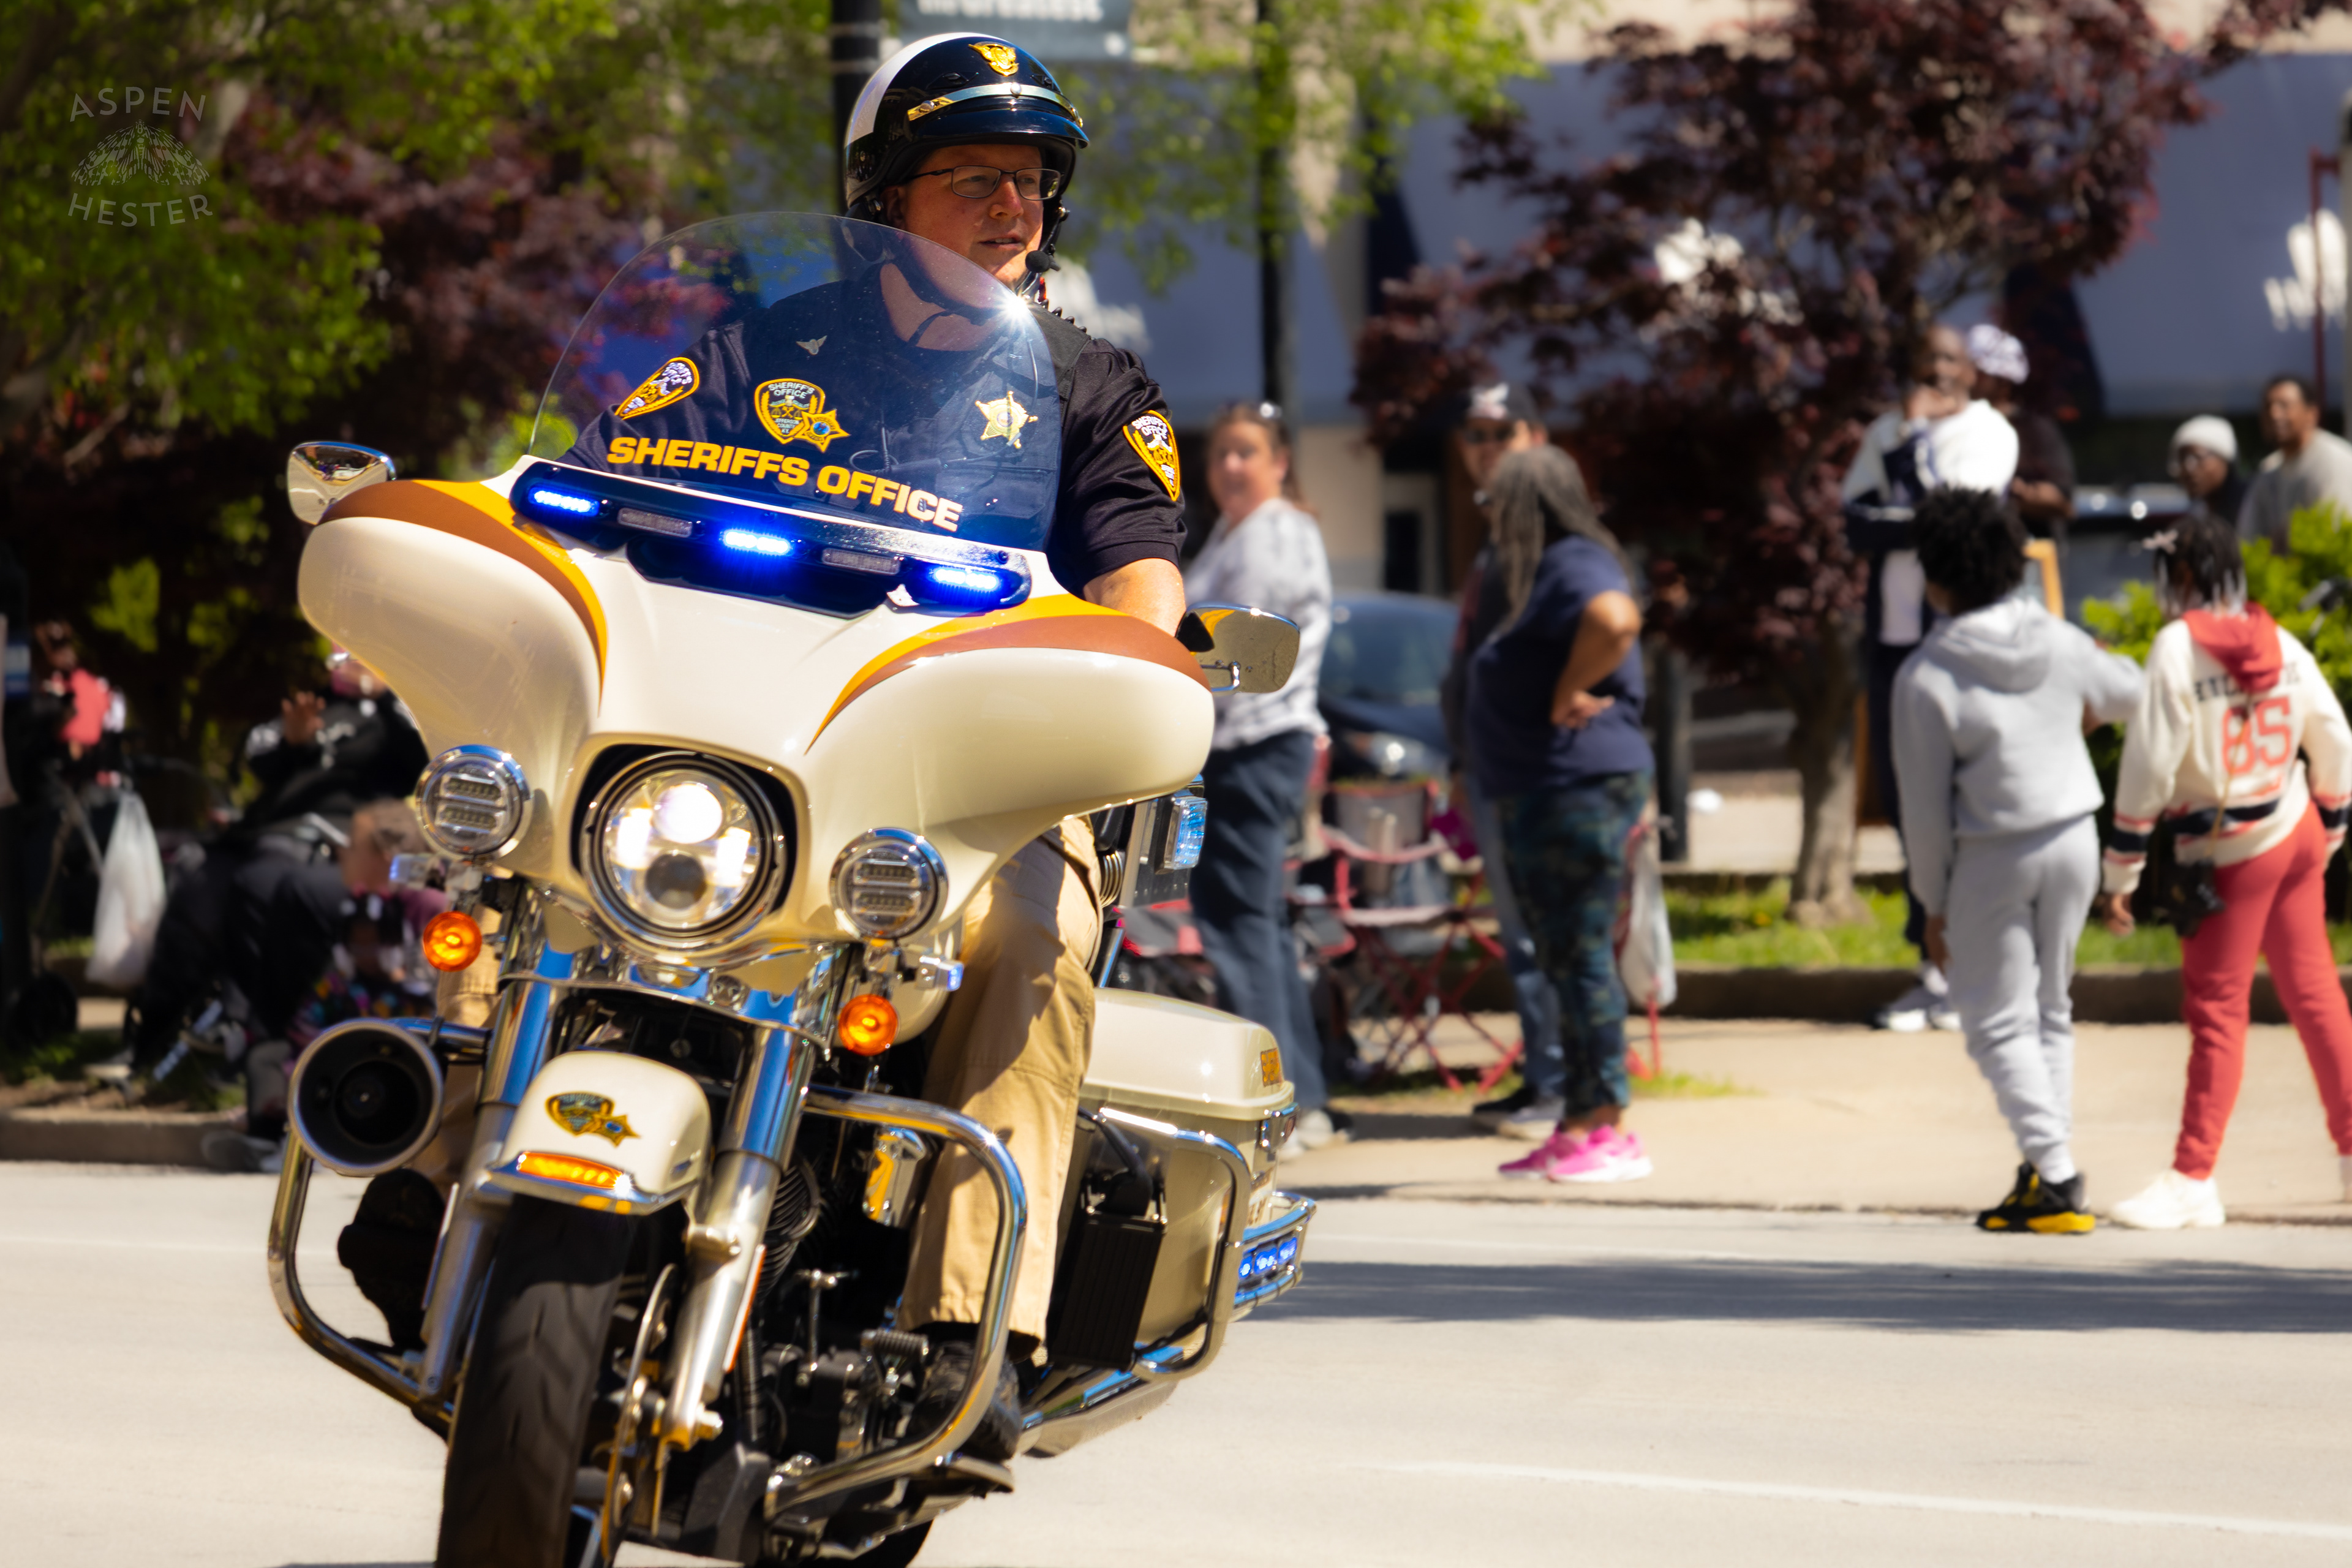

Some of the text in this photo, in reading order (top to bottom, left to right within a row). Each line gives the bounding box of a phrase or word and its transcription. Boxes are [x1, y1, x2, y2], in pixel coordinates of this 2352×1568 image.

[774, 388, 808, 399] OFFICE
[606, 437, 963, 532] SHERIFFS OFFICE
[2222, 695, 2292, 777] 85
